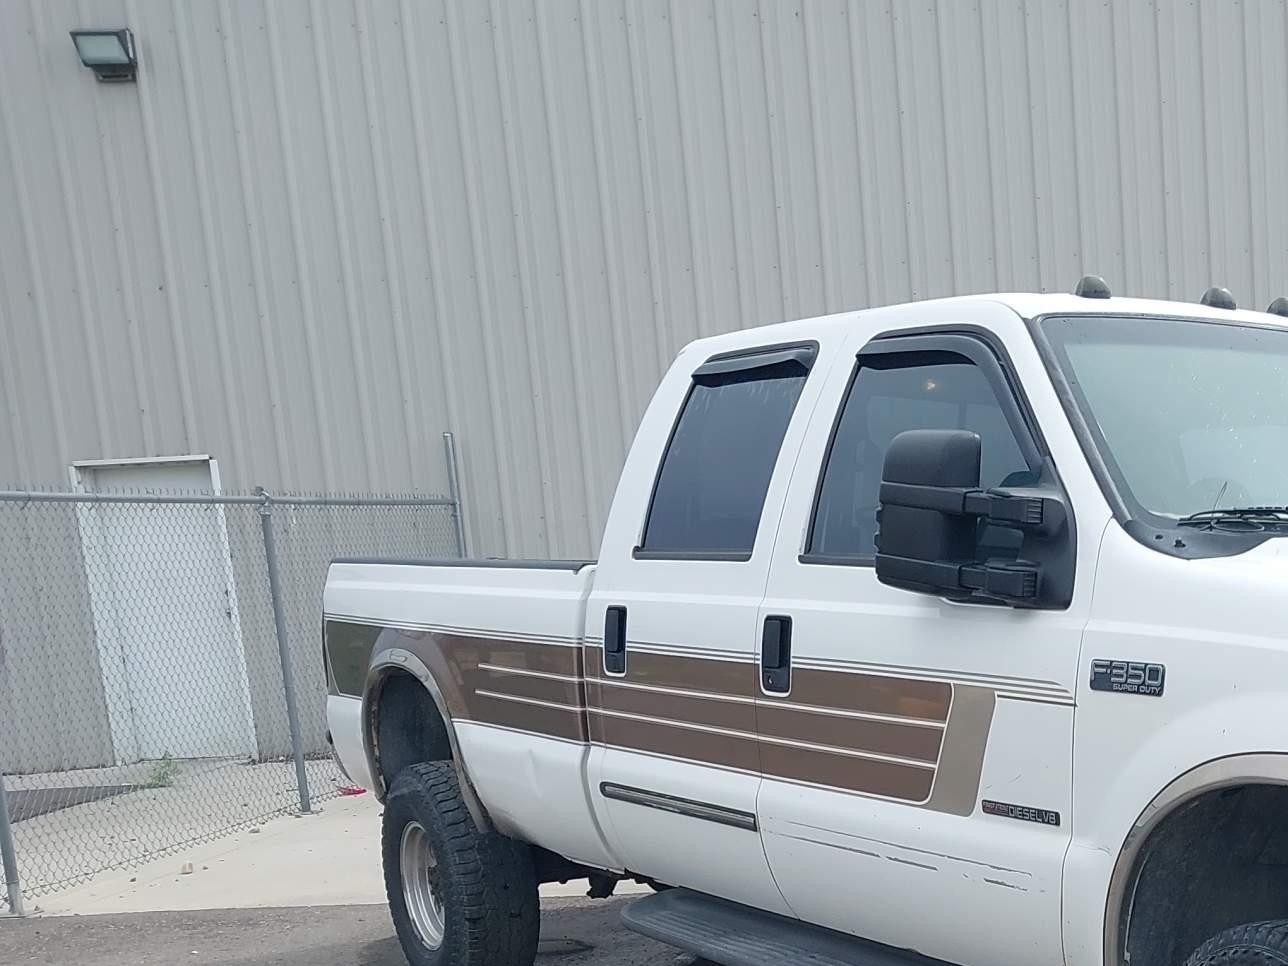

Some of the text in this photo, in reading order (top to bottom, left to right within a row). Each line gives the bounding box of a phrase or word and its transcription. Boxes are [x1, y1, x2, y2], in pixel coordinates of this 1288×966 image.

[1090, 660, 1163, 686] F-350
[1112, 683, 1161, 695] SUPER DUTY
